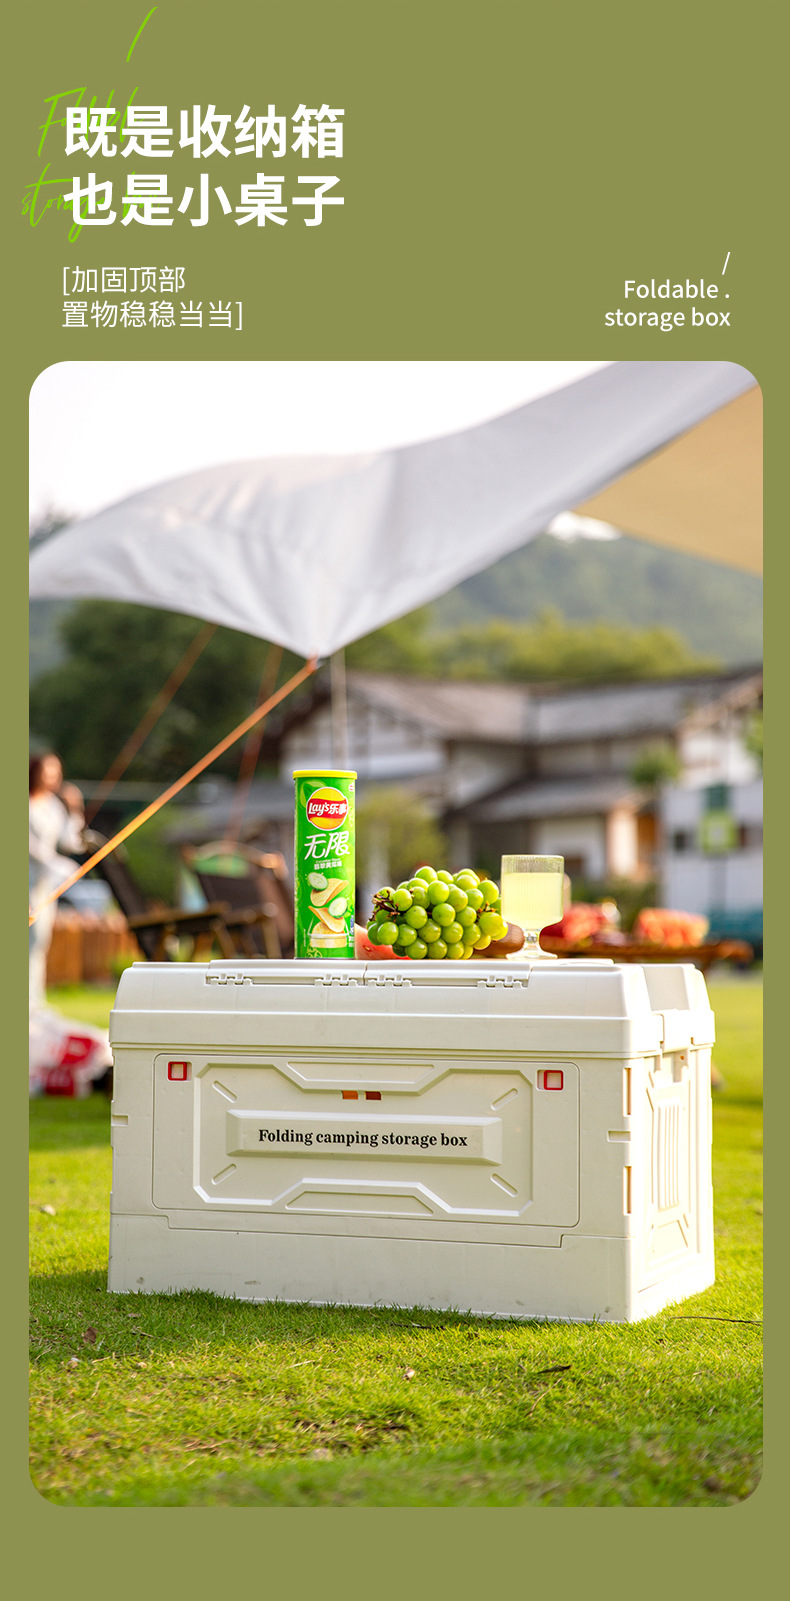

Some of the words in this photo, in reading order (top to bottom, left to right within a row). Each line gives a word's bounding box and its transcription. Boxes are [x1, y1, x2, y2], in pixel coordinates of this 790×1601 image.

[304, 831, 350, 860] 无限
[258, 1129, 313, 1146] Folding
[316, 1131, 378, 1147] camping
[381, 1133, 437, 1148] storage
[440, 1133, 468, 1146] box
